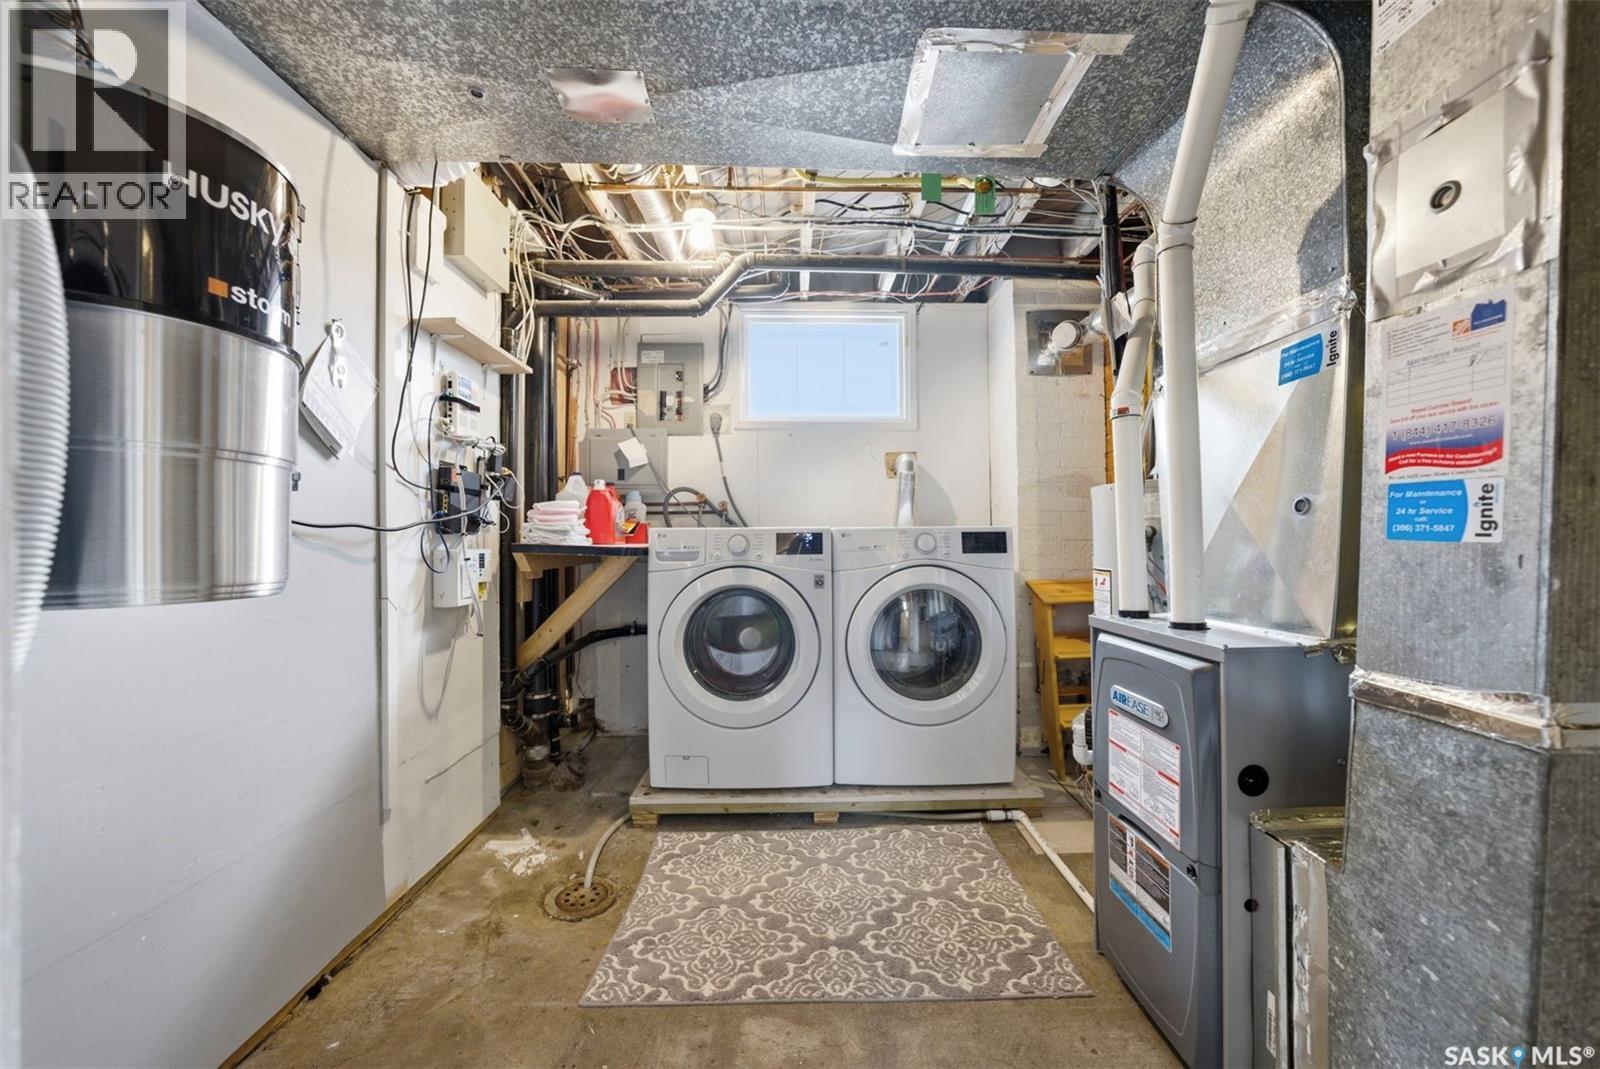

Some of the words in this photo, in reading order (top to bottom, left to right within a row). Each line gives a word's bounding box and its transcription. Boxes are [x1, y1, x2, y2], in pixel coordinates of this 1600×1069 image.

[162, 160, 285, 247] HUSKY
[1326, 330, 1340, 367] Ignite
[1401, 425, 1431, 442] (844)
[1434, 415, 1497, 434] 417-8326
[1389, 490, 1404, 498] For
[1404, 489, 1462, 498] Maintenance
[1407, 507, 1417, 515] hr
[1419, 506, 1453, 515] Service
[1475, 483, 1498, 538] Ignite
[1112, 690, 1149, 718] AIREASE
